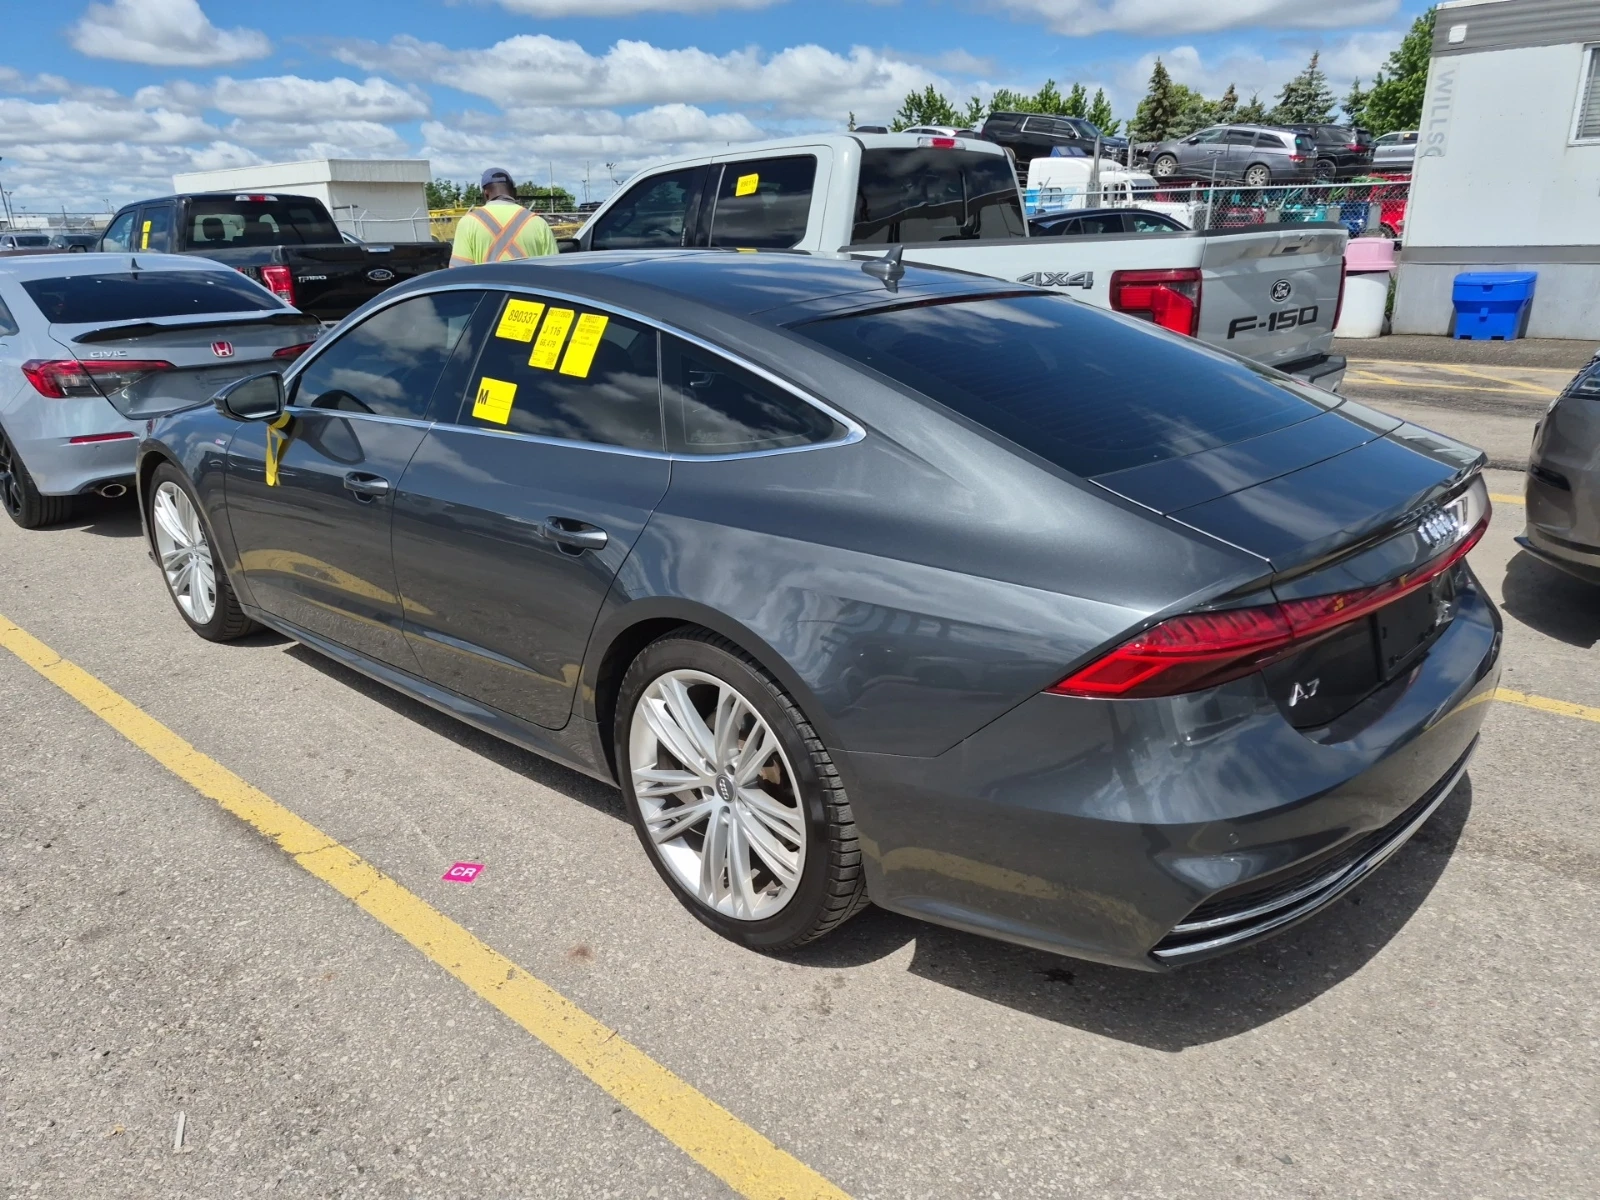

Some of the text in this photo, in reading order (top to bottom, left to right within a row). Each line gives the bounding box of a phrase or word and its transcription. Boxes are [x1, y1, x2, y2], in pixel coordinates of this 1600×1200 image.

[1017, 271, 1094, 289] 4X4
[1272, 281, 1291, 300] Ford
[507, 309, 539, 325] 890337
[1227, 305, 1319, 339] F-150
[542, 324, 550, 334] J
[90, 350, 128, 359] CIVIC
[477, 388, 490, 406] M
[1288, 677, 1321, 707] A7
[450, 866, 477, 877] CR
